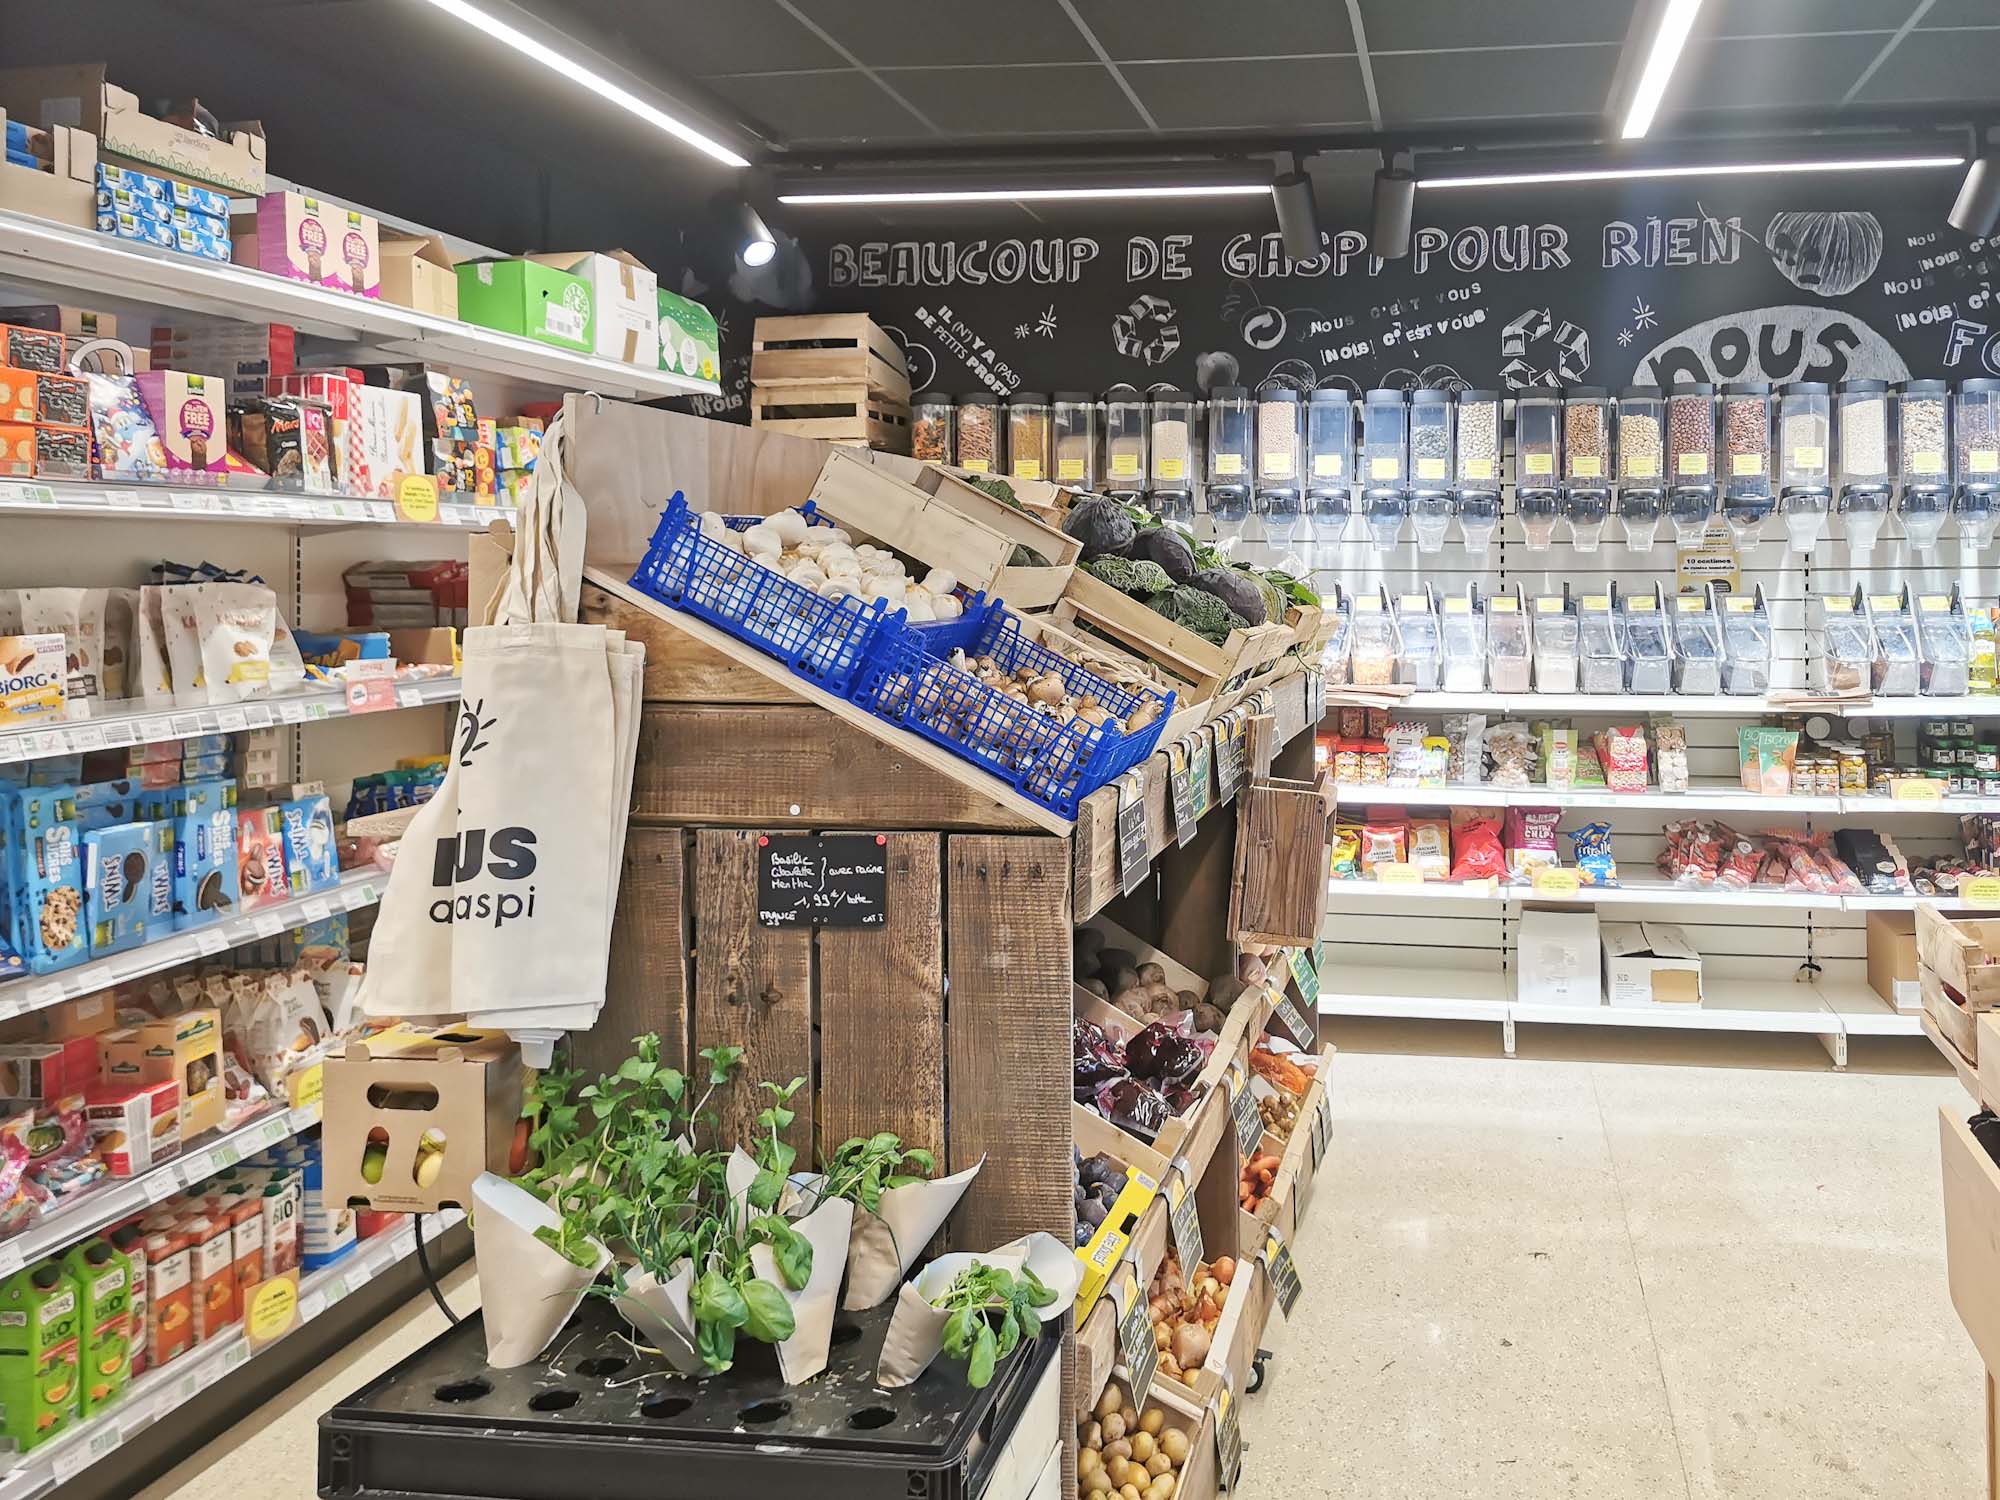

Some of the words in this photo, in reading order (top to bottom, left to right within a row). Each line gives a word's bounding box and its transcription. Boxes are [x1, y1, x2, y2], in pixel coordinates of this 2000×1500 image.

[303, 229, 325, 242] FREE
[347, 243, 368, 257] FREE
[828, 236, 1100, 287] BEAUCOUP
[1126, 234, 1194, 283] DE
[1414, 224, 1571, 273] POUR
[1602, 217, 1742, 267] RIEN
[914, 305, 938, 329] DE
[932, 324, 969, 361] PETITS
[937, 304, 953, 325] IL
[971, 335, 987, 351] Y
[980, 348, 997, 366] A
[993, 361, 1021, 390] (PAS)
[184, 411, 210, 427] FREE
[829, 868, 854, 876] avec
[855, 864, 885, 875] racine
